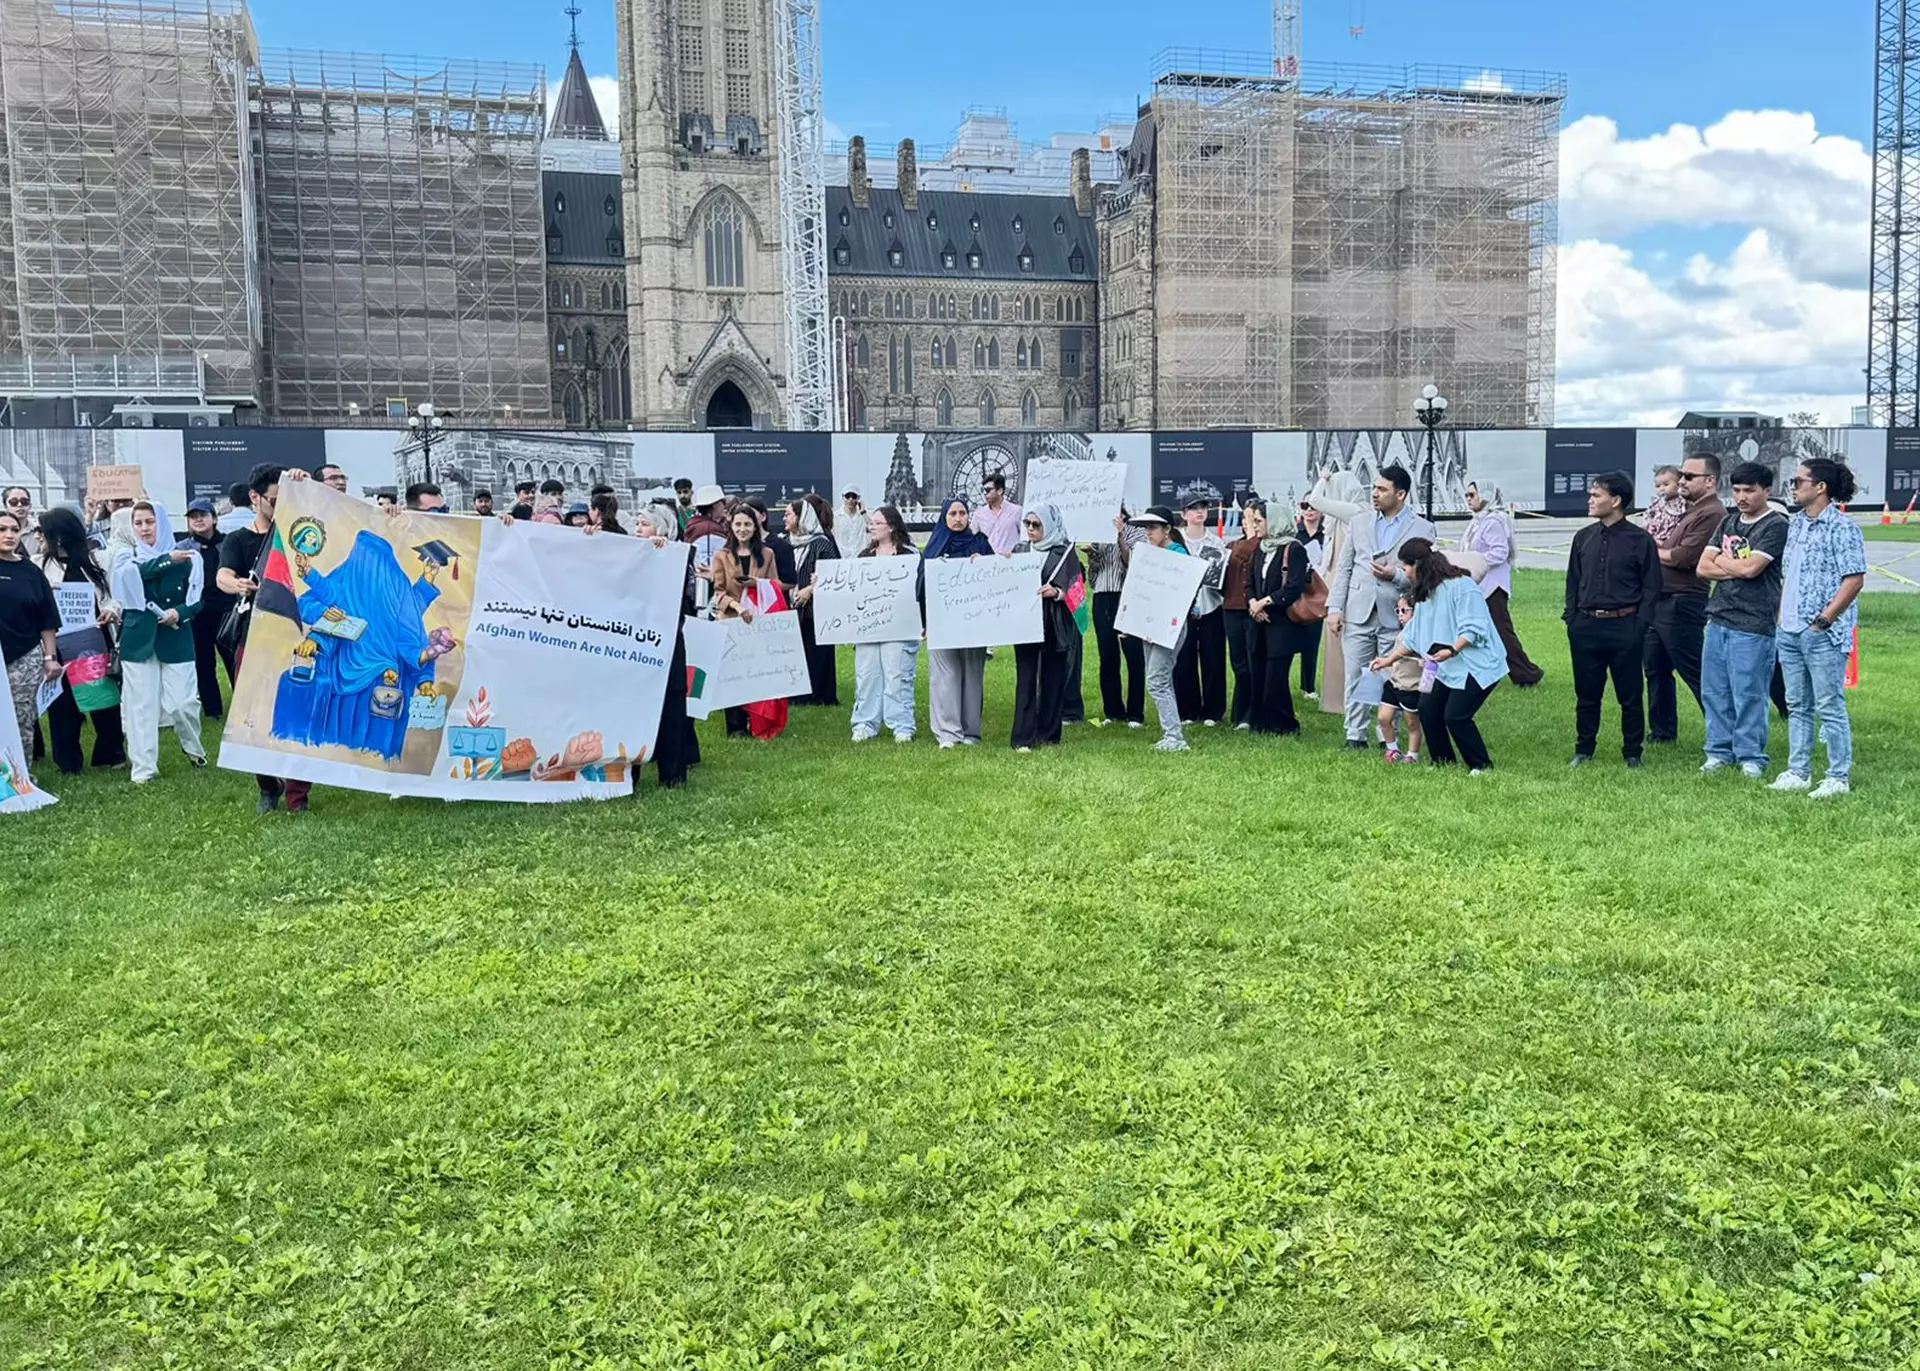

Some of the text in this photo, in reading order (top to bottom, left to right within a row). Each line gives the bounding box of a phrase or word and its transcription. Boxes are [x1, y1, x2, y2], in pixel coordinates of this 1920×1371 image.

[60, 591, 89, 599] FREEDOM
[76, 600, 92, 608] RIGHT
[483, 602, 662, 647] زنان افغانستان تنها نیستند
[475, 622, 665, 668] Afghan Women Are Not Alone
